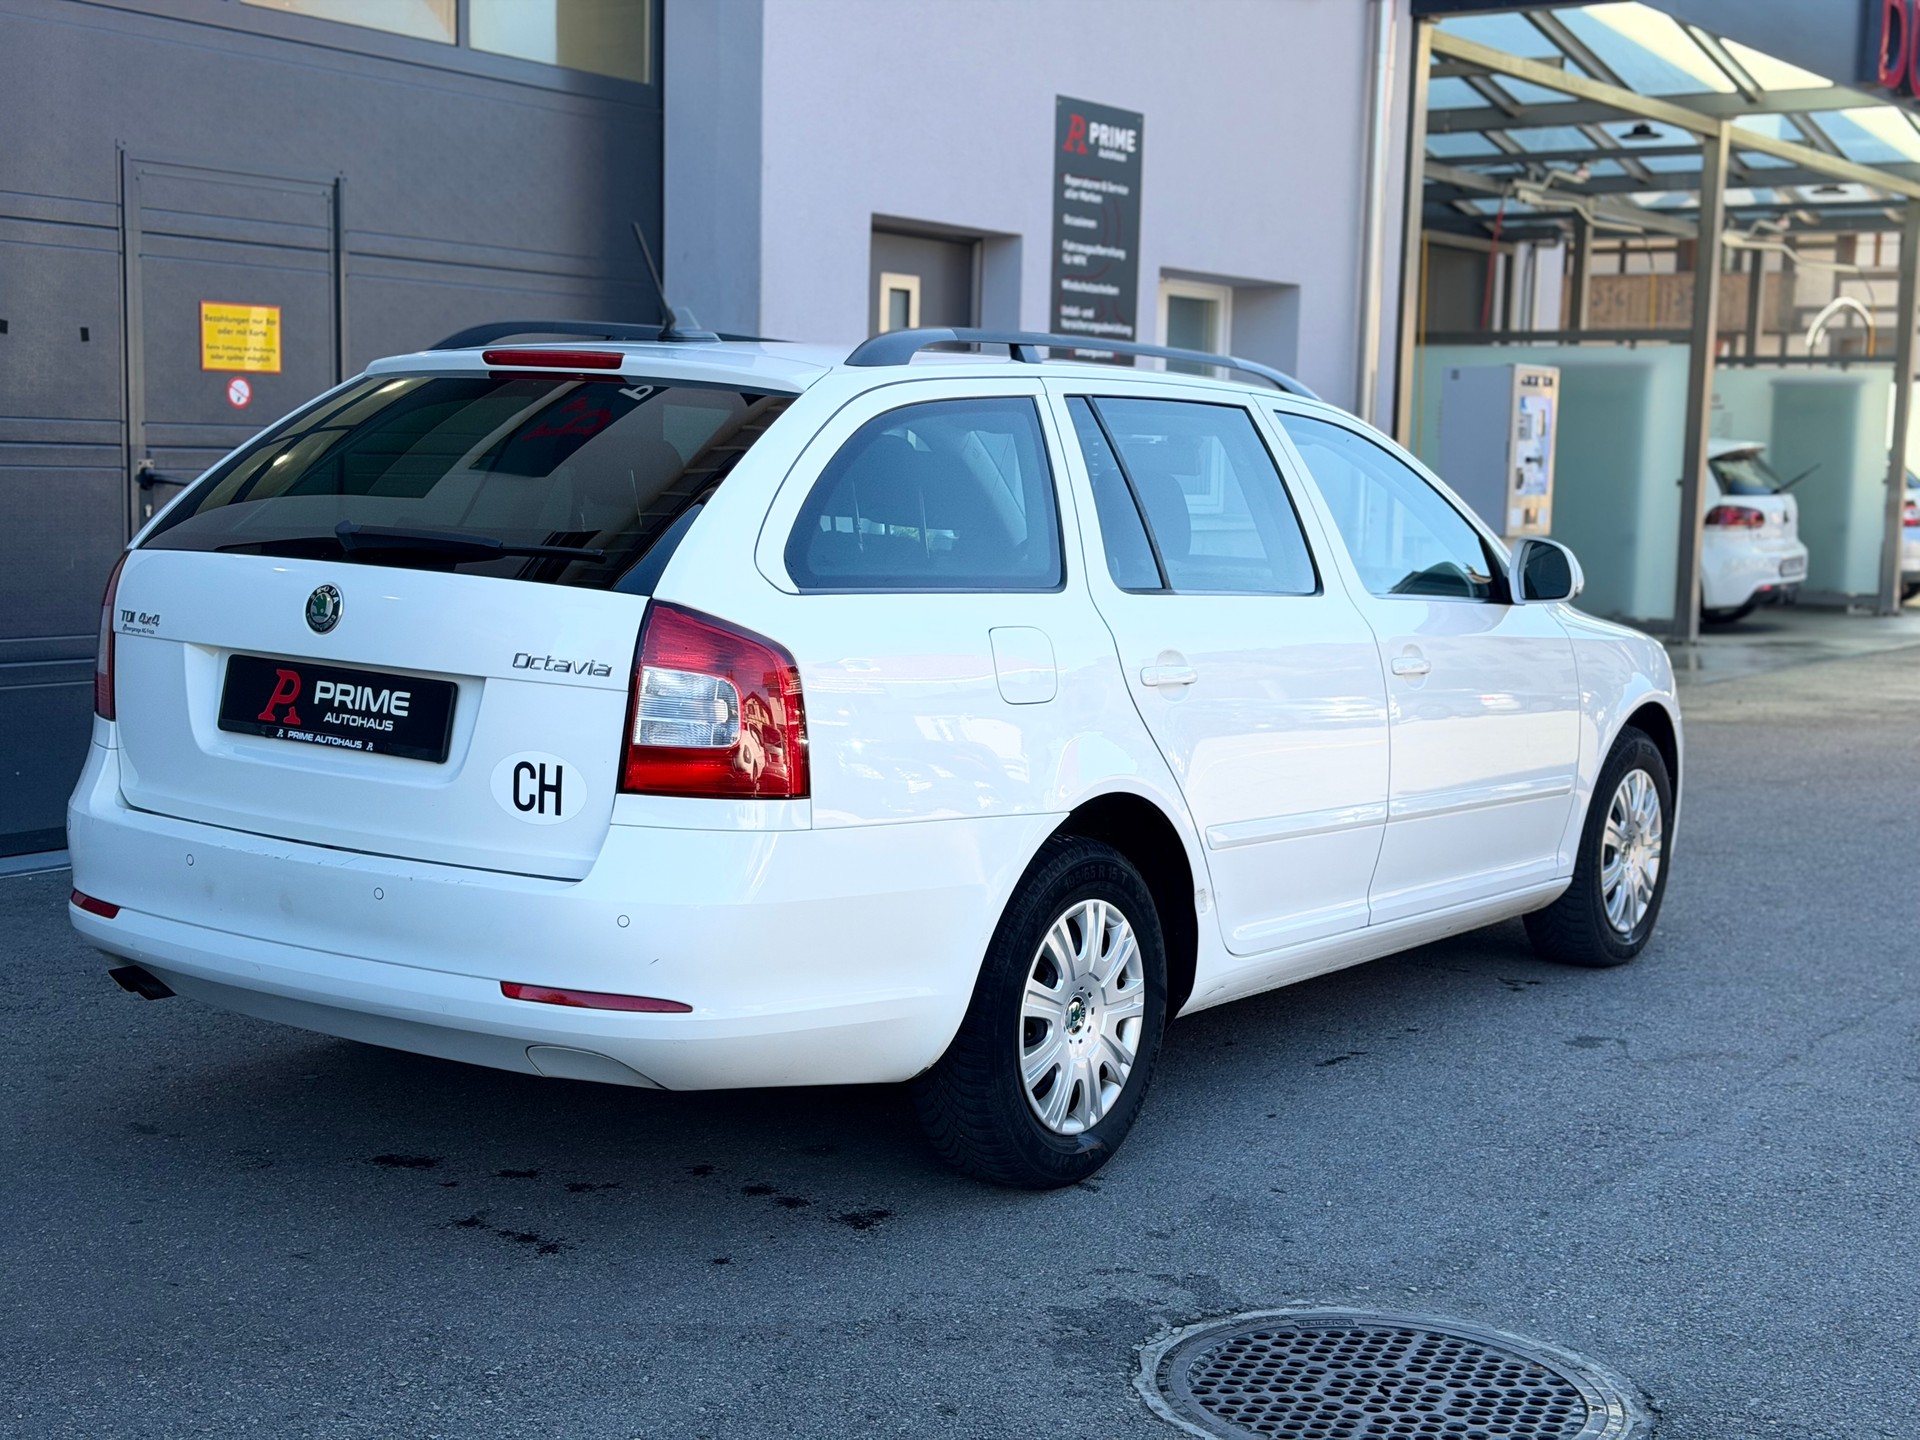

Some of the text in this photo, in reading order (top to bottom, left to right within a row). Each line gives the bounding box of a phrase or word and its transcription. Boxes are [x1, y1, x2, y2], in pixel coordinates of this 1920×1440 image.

[1089, 121, 1137, 153] PRIME
[217, 327, 234, 335] oder
[120, 609, 161, 627] TDI 4x4
[512, 652, 612, 678] Octavia
[314, 680, 411, 717] PRIME
[323, 712, 394, 731] AUTOHAUS
[287, 730, 314, 742] PRIME
[314, 734, 363, 749] AUTOHAUS
[513, 760, 563, 816] CH
